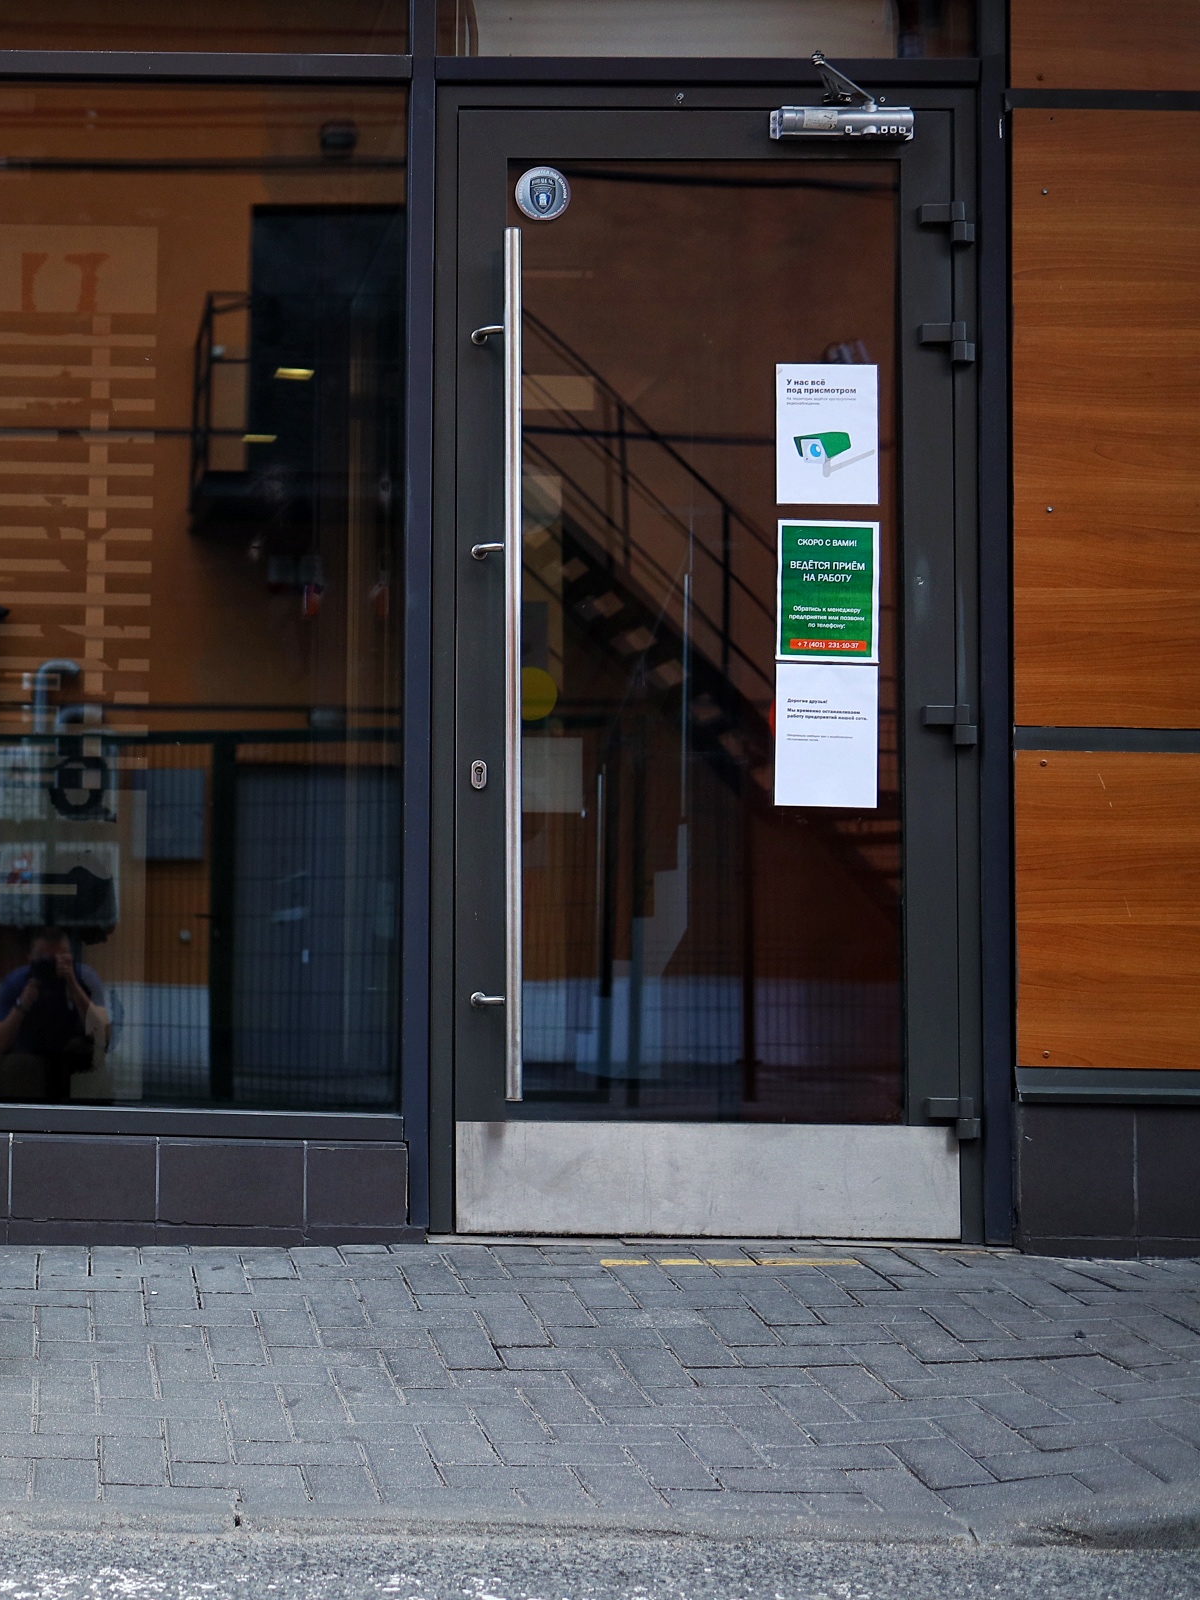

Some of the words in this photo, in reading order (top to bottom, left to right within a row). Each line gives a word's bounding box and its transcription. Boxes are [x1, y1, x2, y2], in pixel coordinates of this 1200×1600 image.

[790, 560, 830, 570] ВЕДЁТСЯ
[833, 561, 865, 570] ПРИЁМ
[818, 574, 852, 582] РАБОТУ
